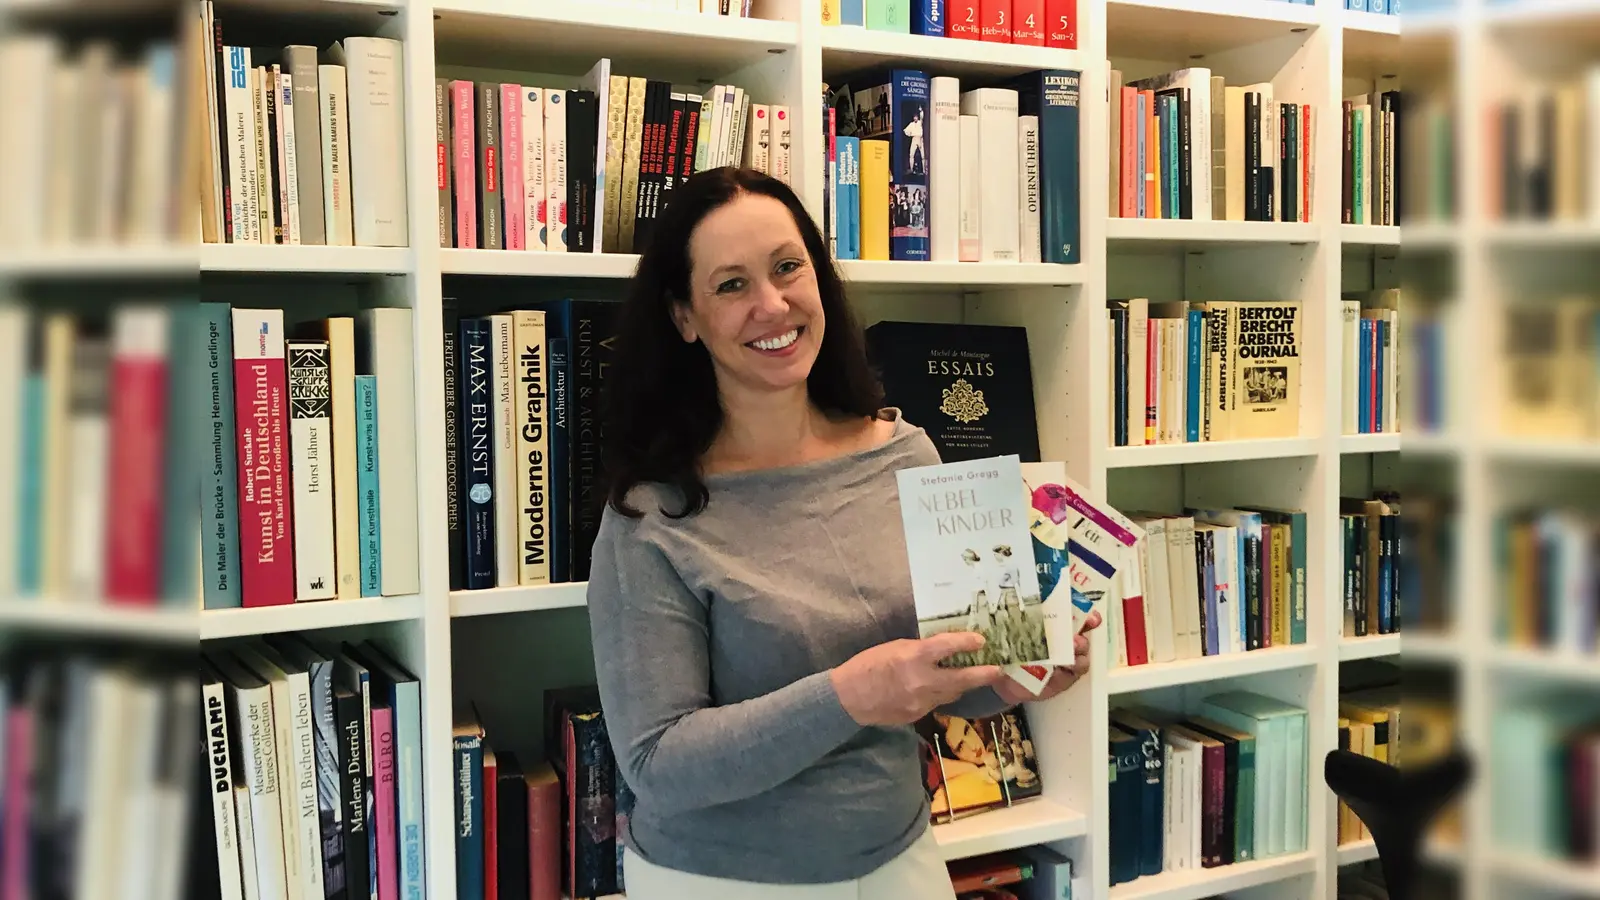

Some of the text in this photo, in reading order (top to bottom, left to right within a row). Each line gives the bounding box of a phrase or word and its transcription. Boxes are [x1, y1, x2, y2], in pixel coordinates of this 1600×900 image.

[966, 8, 974, 23] 2
[998, 11, 1004, 25] 3
[1026, 14, 1035, 28] 4
[1060, 16, 1068, 30] 5
[1045, 76, 1078, 86] LEXIKON
[507, 92, 516, 112] Weiß
[664, 110, 682, 190] Tod beim Martinszug
[682, 111, 697, 176] beim Martinszug
[1025, 130, 1036, 212] OPERNFÜHRER
[241, 199, 250, 240] Geschichte
[253, 231, 258, 240] im
[1240, 307, 1297, 320] BERTOLT
[1240, 320, 1294, 332] BRECHT
[499, 322, 509, 379] Liebermann
[580, 319, 592, 379] KUNST
[1238, 332, 1294, 345] ARBEITS
[1239, 346, 1298, 358] OURNAL
[928, 360, 994, 376] ESSAIS
[363, 384, 372, 407] das?
[445, 369, 455, 408] GRUBER
[501, 382, 509, 403] Max
[556, 370, 566, 428] Architektur
[580, 387, 592, 398] &
[364, 409, 372, 420] ist
[446, 410, 456, 448] GROSSE
[470, 344, 488, 476] MAX ERNST
[208, 321, 228, 591] Die Maler der Brücke Sammlung Hermann Gerlinger
[243, 428, 254, 501] Robert Suckale
[252, 364, 274, 564] Kunst in Deutschland
[271, 387, 284, 539] Von Karl dem Großen bis Heute
[307, 426, 319, 493] Horst Jähner
[521, 344, 545, 565] Moderne Graphik
[447, 450, 457, 531] PHOTOGRAPHEN
[920, 470, 999, 486] Stefanie Gregg
[366, 489, 375, 536] Kunsthalle
[918, 488, 982, 514] NEBEL
[936, 508, 1014, 536] KINDER
[310, 577, 324, 591] wk
[368, 540, 378, 590] Hamburger
[297, 692, 308, 728] leben
[323, 675, 333, 722] Häuser
[208, 696, 229, 793] DUCHAMP
[248, 704, 264, 795] Meisterwerke der
[260, 701, 275, 793] Barnes Collection
[300, 733, 313, 789] Büchern
[379, 732, 392, 783] BÜRO
[346, 720, 363, 832] Marlene Dietrich
[460, 752, 474, 837] Schauspielführer
[304, 794, 316, 818] Mit
[405, 824, 418, 841] DIE
